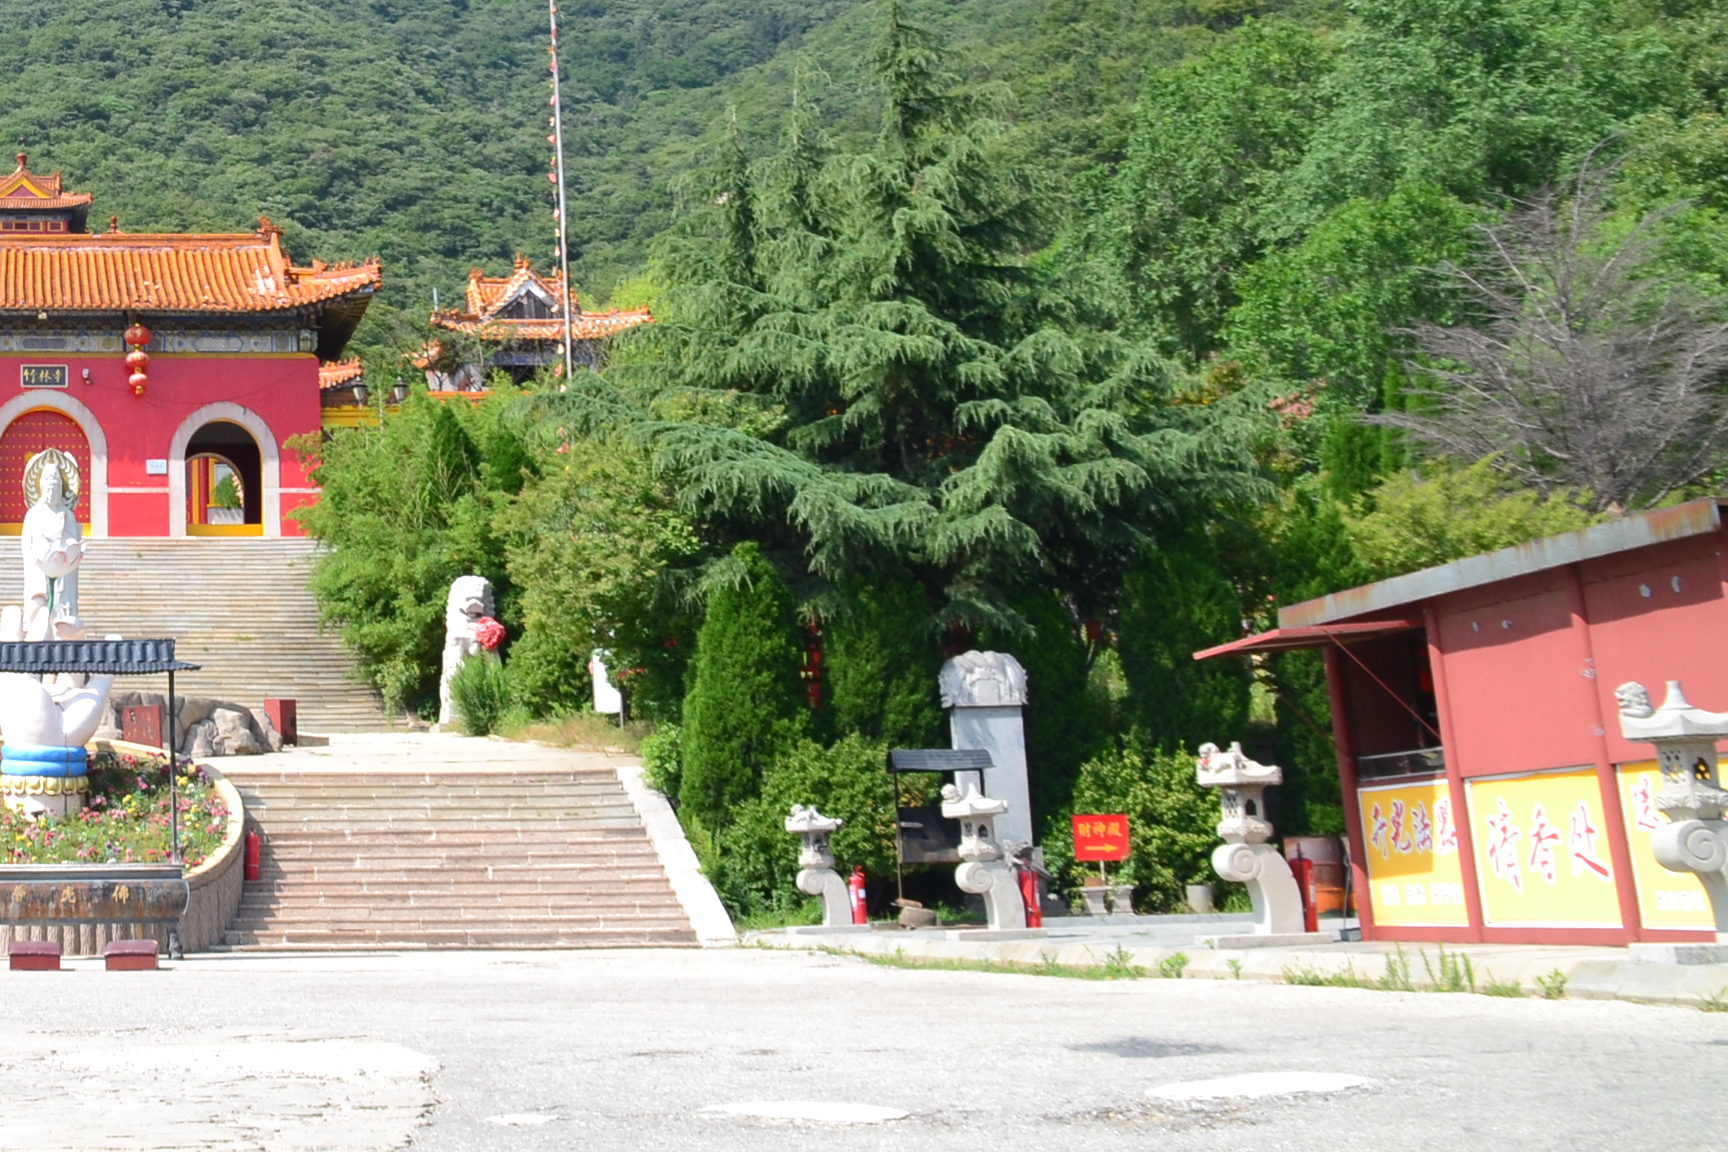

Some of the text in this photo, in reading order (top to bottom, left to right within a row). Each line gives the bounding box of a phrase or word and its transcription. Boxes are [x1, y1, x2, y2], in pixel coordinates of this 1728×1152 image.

[23, 368, 62, 384] 竹林寺
[1077, 821, 1123, 838] 财神殿
